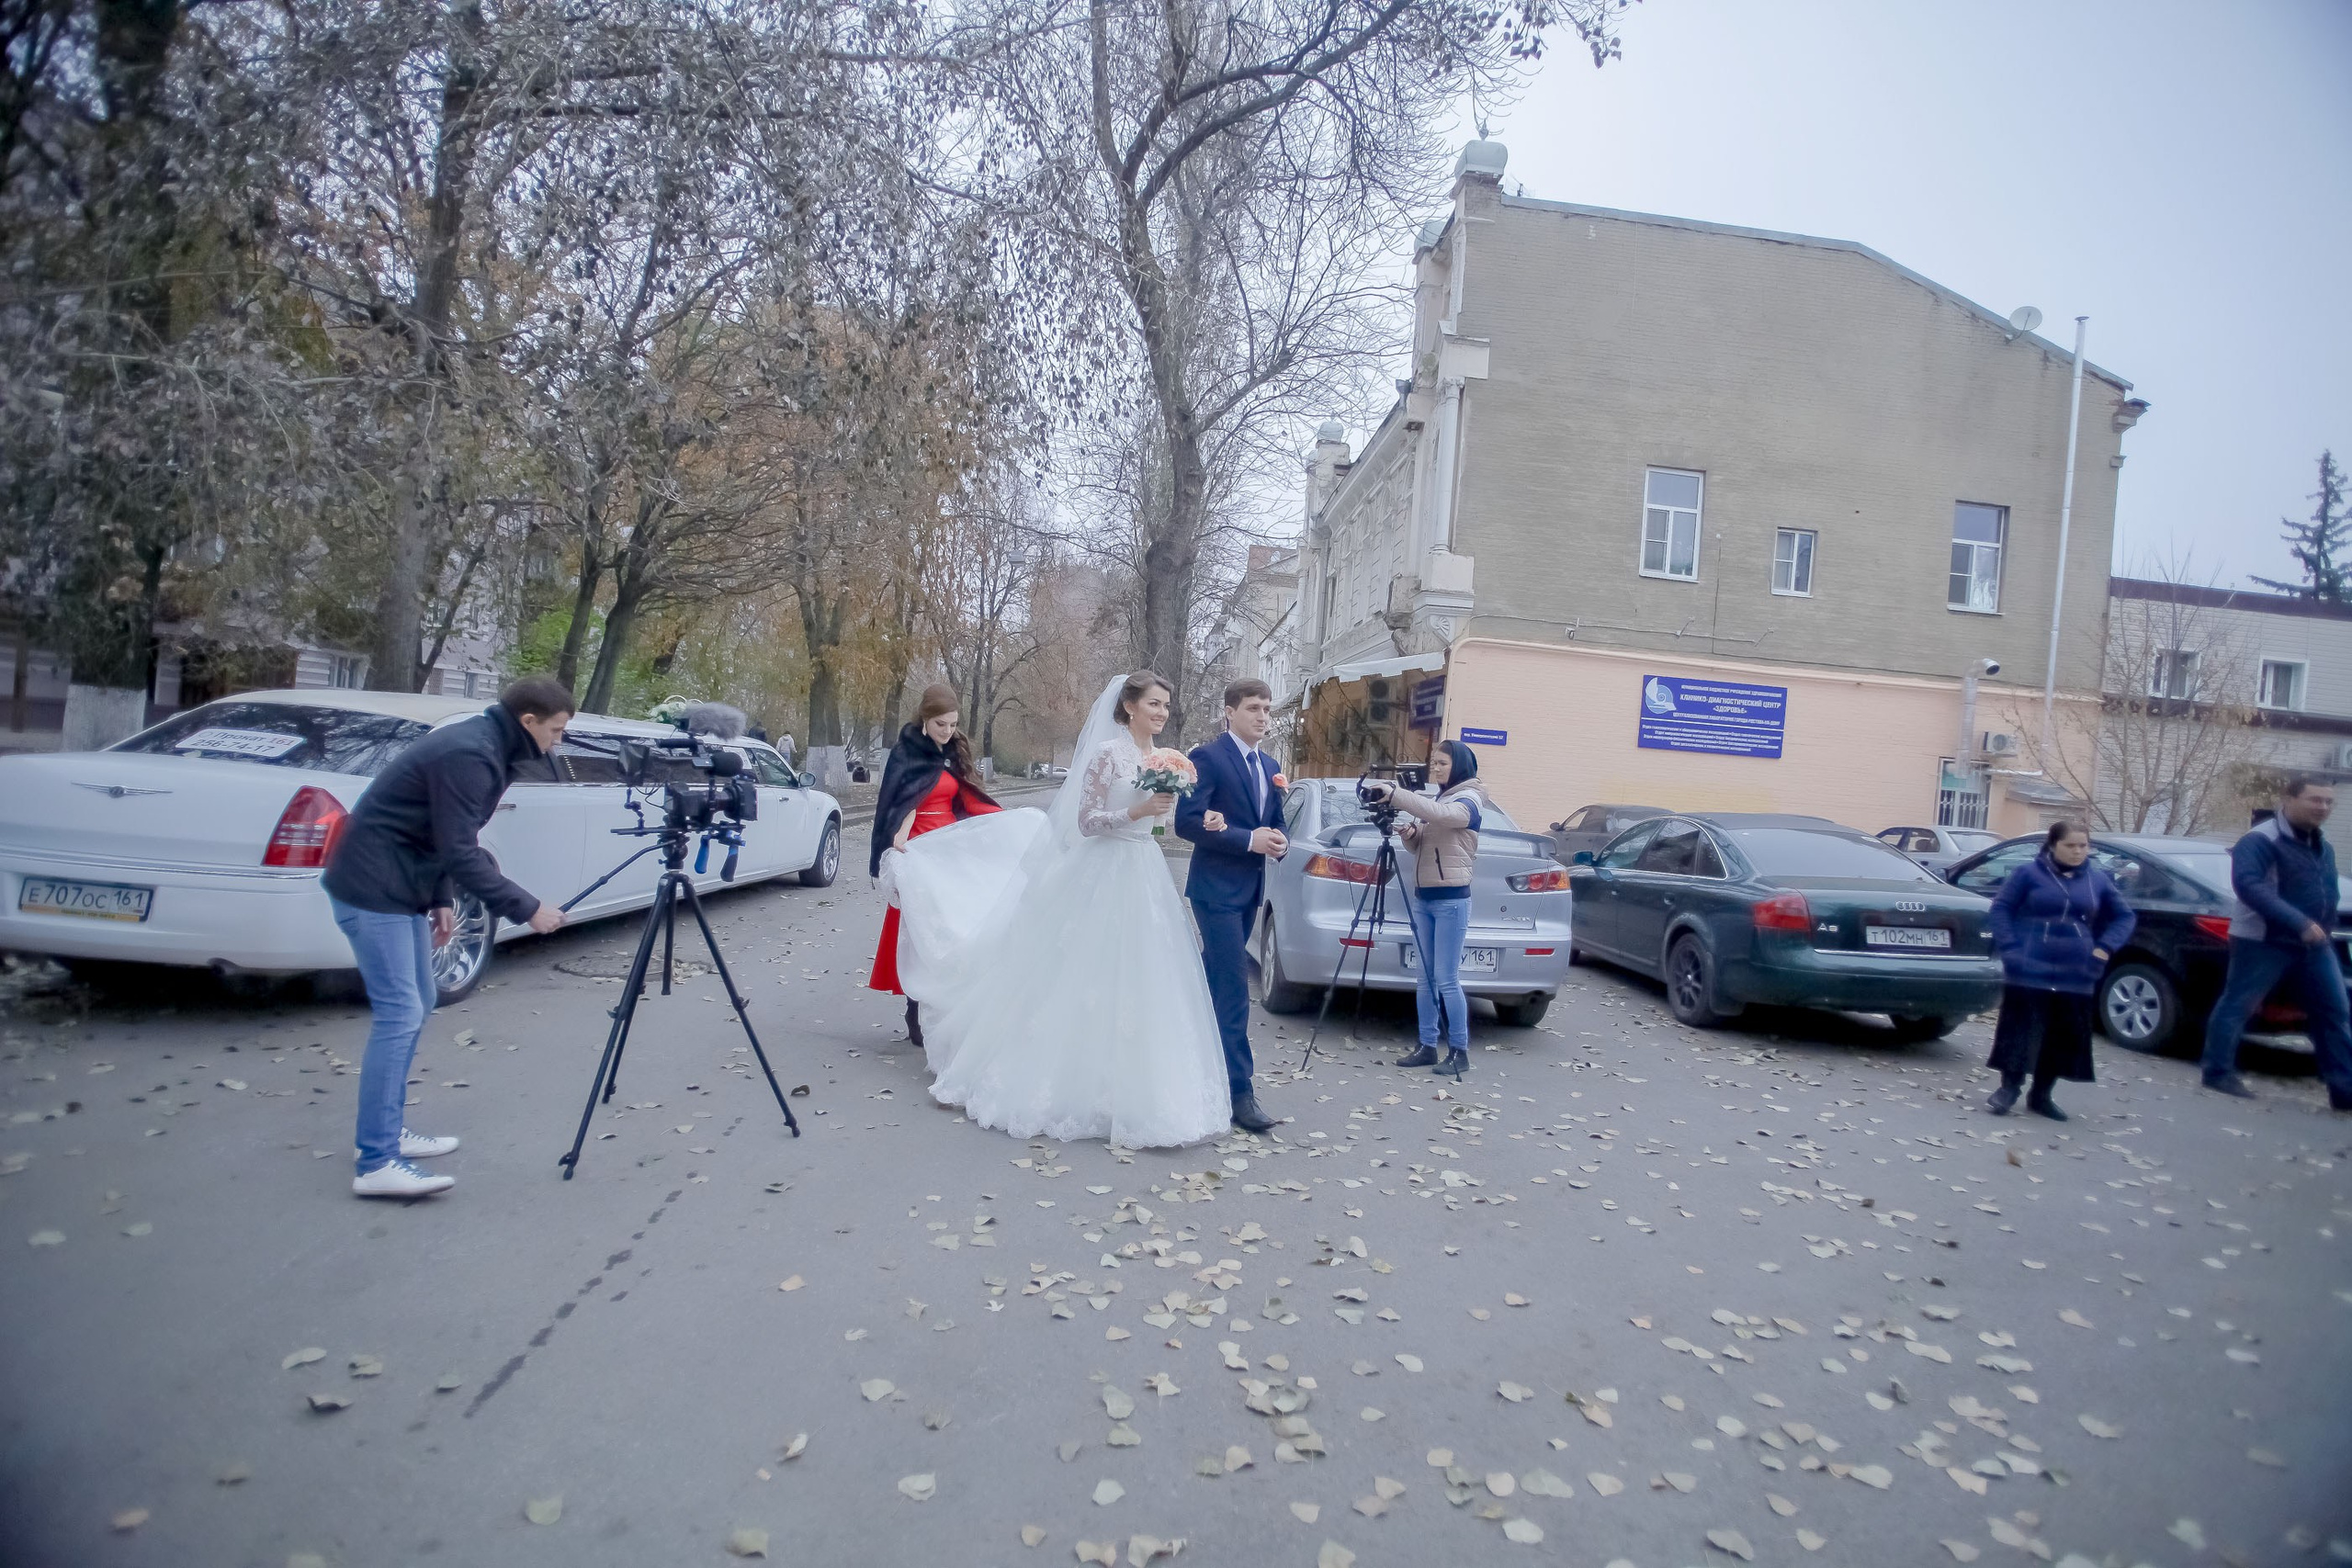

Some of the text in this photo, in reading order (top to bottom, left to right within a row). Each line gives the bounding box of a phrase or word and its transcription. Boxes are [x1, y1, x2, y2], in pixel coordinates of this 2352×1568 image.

[1713, 705, 1747, 714] «ЗДОРОВЬЕ»
[191, 739, 276, 752] 256-74-17
[213, 732, 295, 746] Прокат 161
[28, 884, 143, 908] Е707ОС 161
[1871, 930, 1946, 944] Т102МН 161
[1471, 950, 1492, 962] 161
